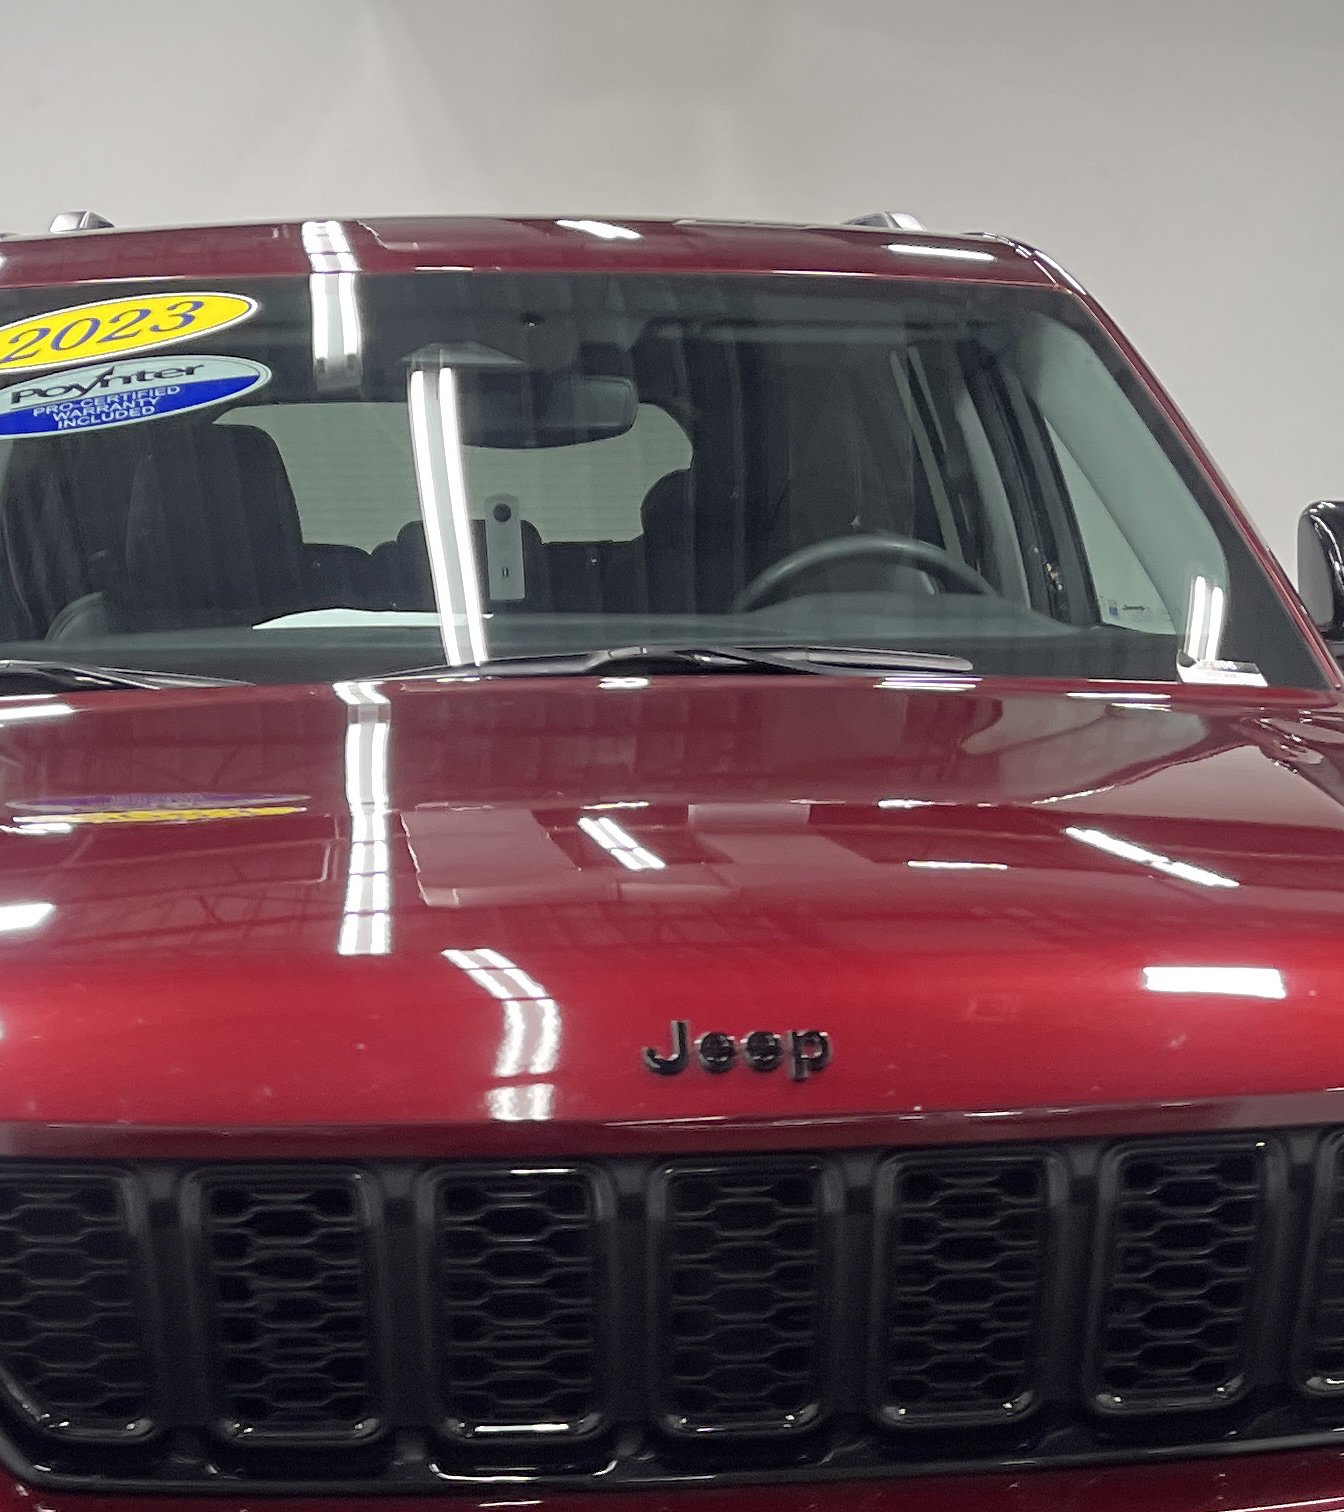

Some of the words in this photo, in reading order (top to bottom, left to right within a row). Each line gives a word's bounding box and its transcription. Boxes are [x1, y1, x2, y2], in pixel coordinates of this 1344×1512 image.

[33, 386, 181, 417] PRO-CERTIFIED
[52, 396, 160, 422] WARRANTY
[57, 405, 156, 430] INCLUDED
[642, 1019, 832, 1082] Jeep
